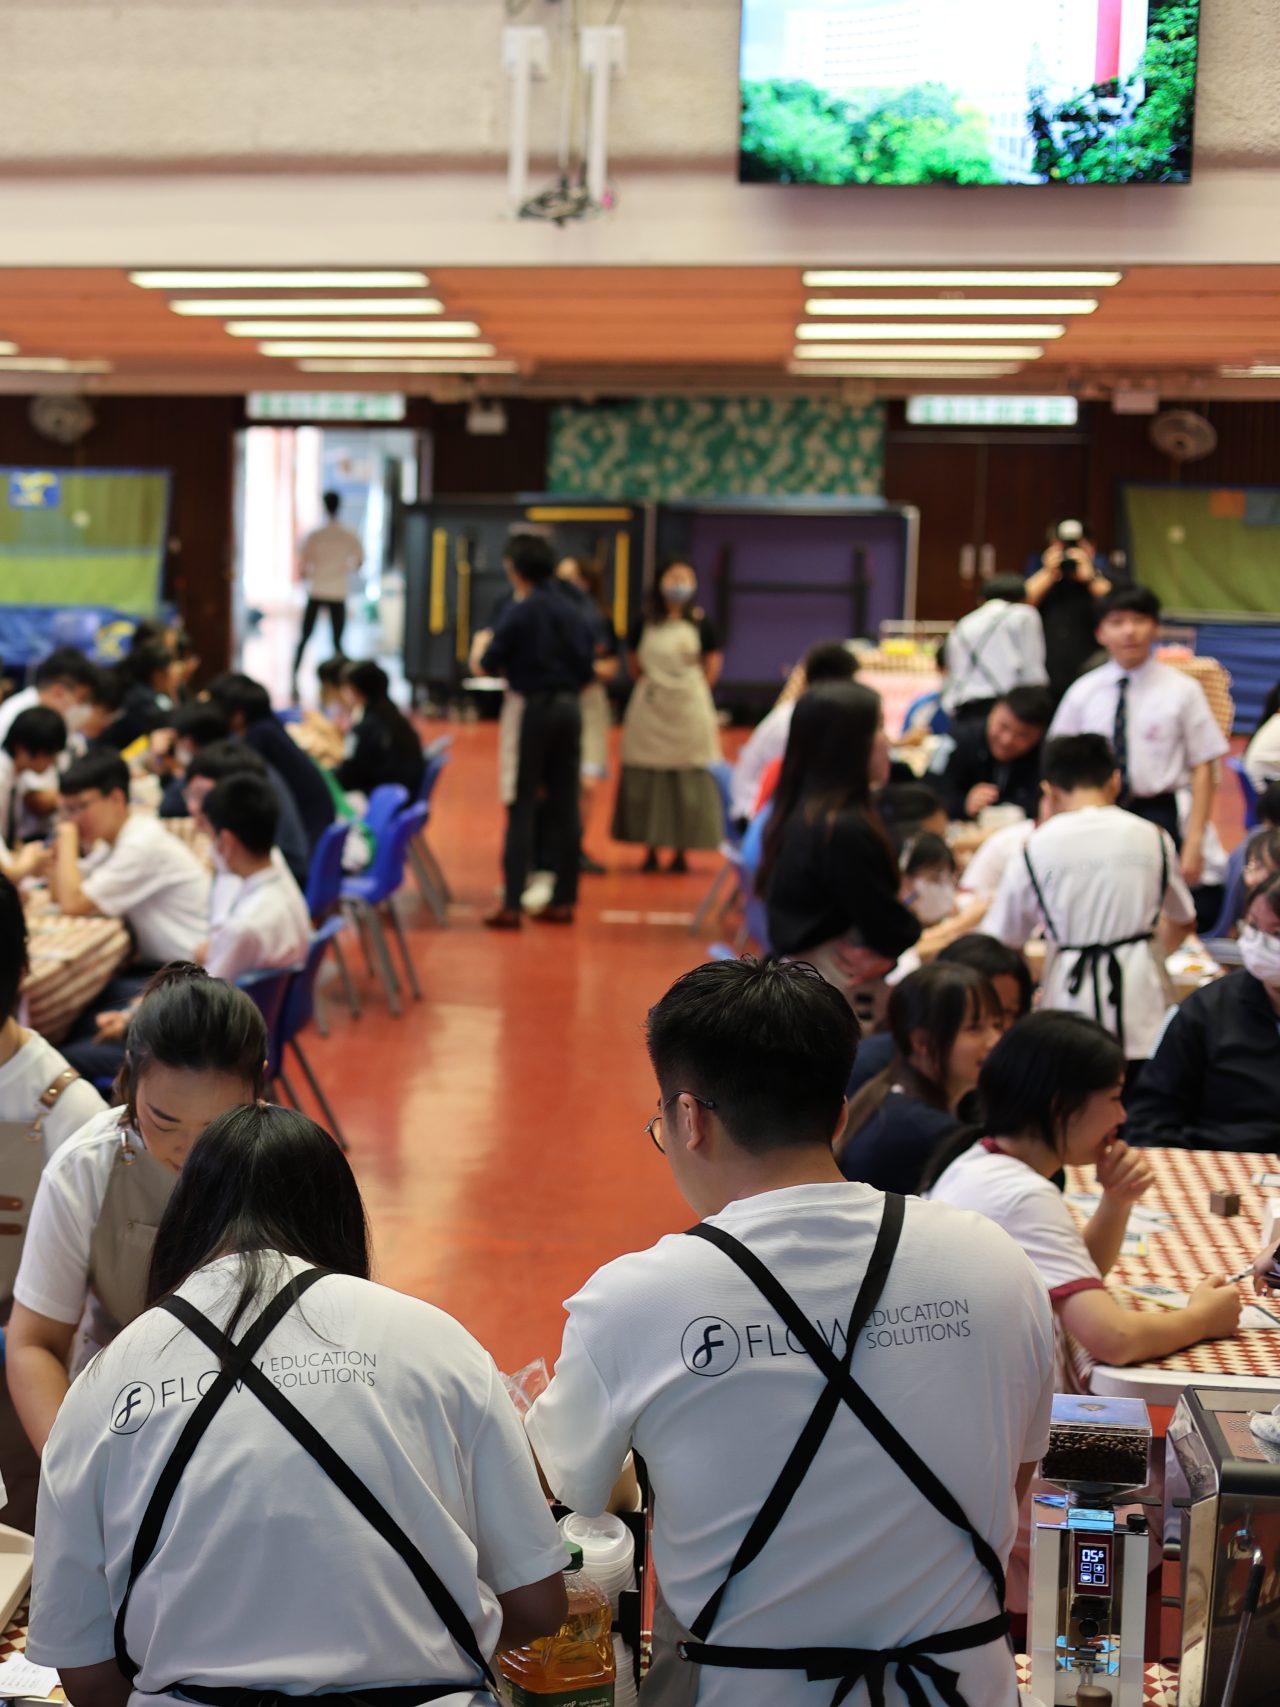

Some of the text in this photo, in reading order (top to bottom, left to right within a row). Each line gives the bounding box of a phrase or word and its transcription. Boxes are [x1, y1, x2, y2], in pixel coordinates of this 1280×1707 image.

[866, 1319, 971, 1350] SOLUTIONS
[271, 1350, 377, 1372] EDUCATION
[273, 1368, 376, 1389] SOLUTIONS
